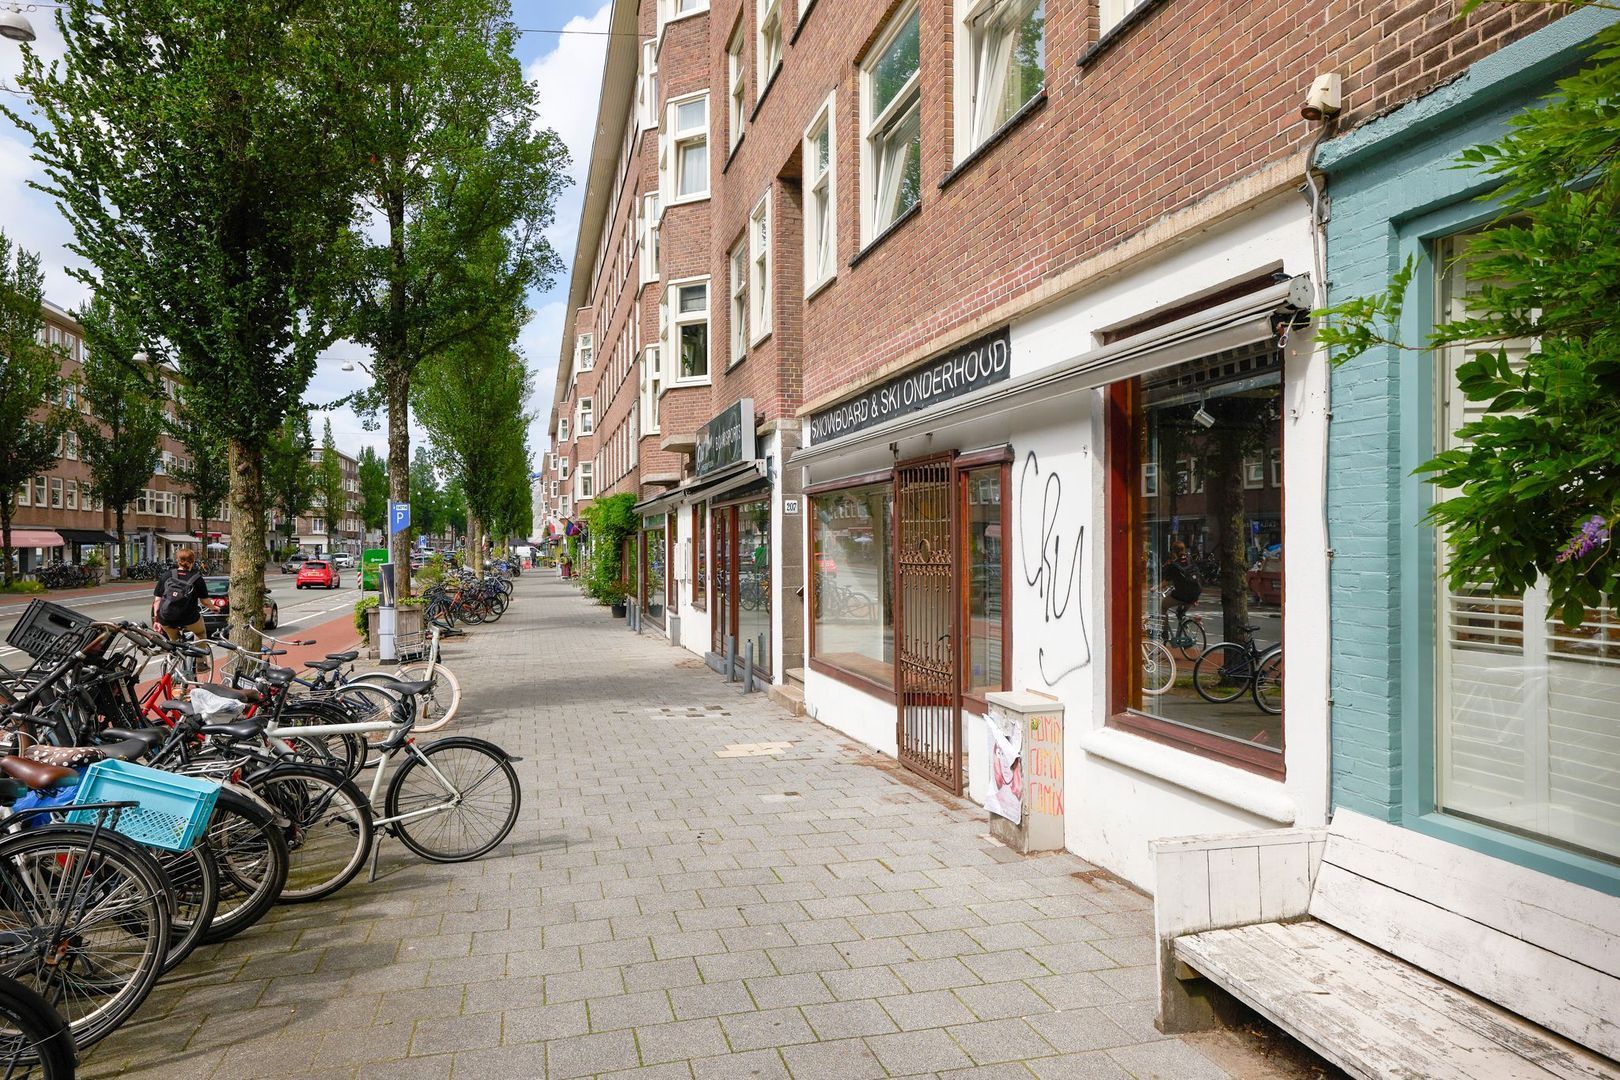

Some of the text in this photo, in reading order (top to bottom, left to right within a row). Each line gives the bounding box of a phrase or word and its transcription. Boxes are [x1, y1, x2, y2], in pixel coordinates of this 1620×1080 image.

[811, 339, 1007, 439] SNOWBOARD & SKI ONDERHOUD
[786, 502, 797, 511] 207
[396, 511, 404, 524] P
